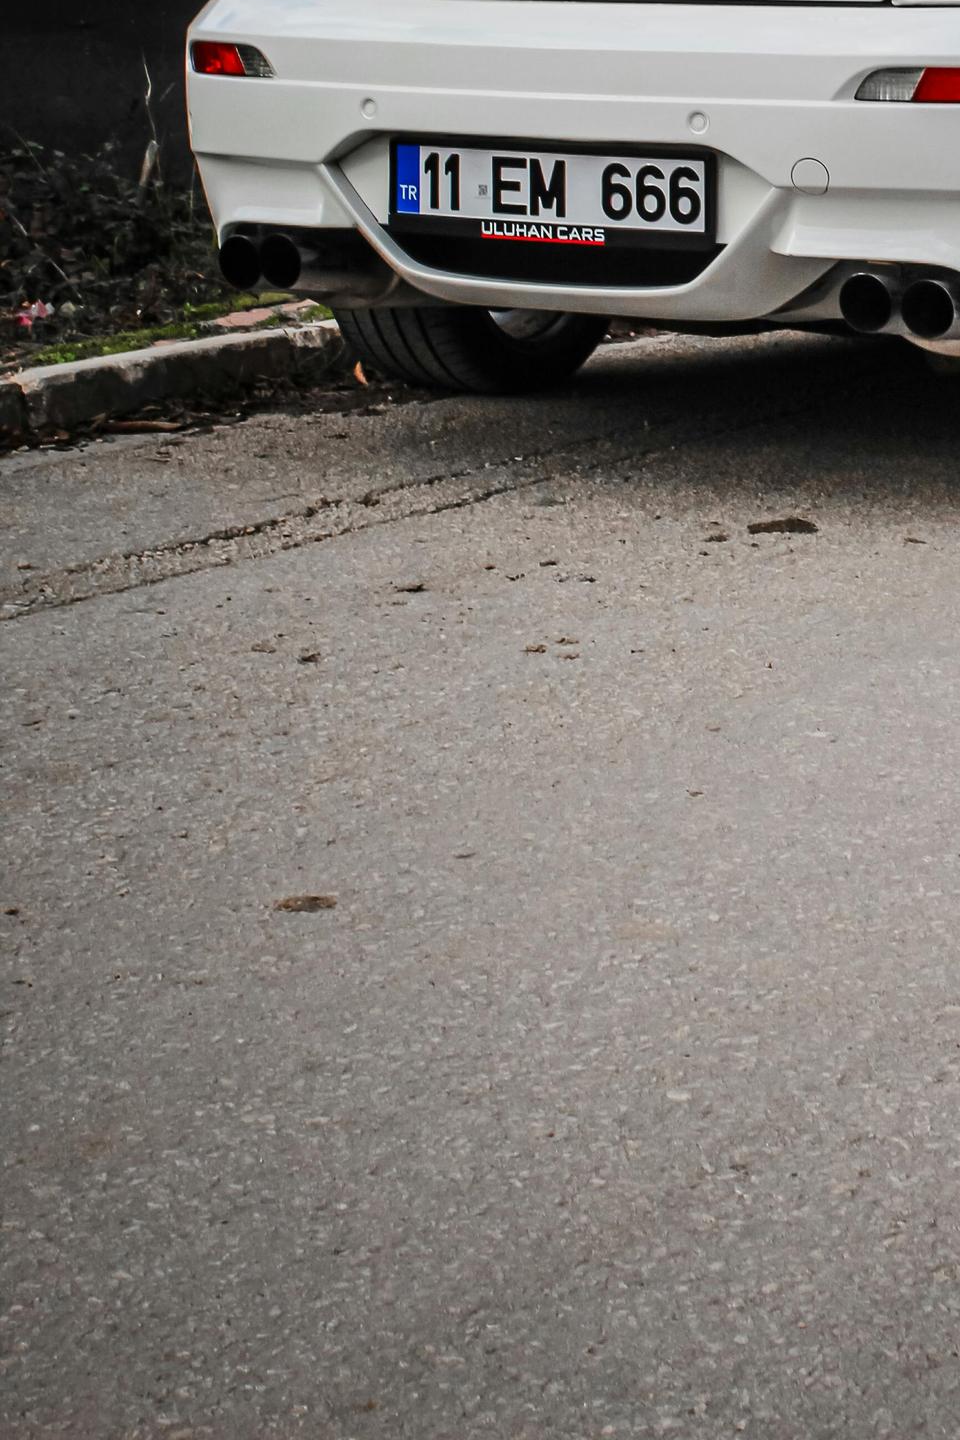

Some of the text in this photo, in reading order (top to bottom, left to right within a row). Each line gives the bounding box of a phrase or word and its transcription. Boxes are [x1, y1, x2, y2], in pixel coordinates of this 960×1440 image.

[399, 184, 417, 201] TR
[423, 152, 702, 225] 11 EM 666
[481, 221, 605, 242] ULUHAN CARS
